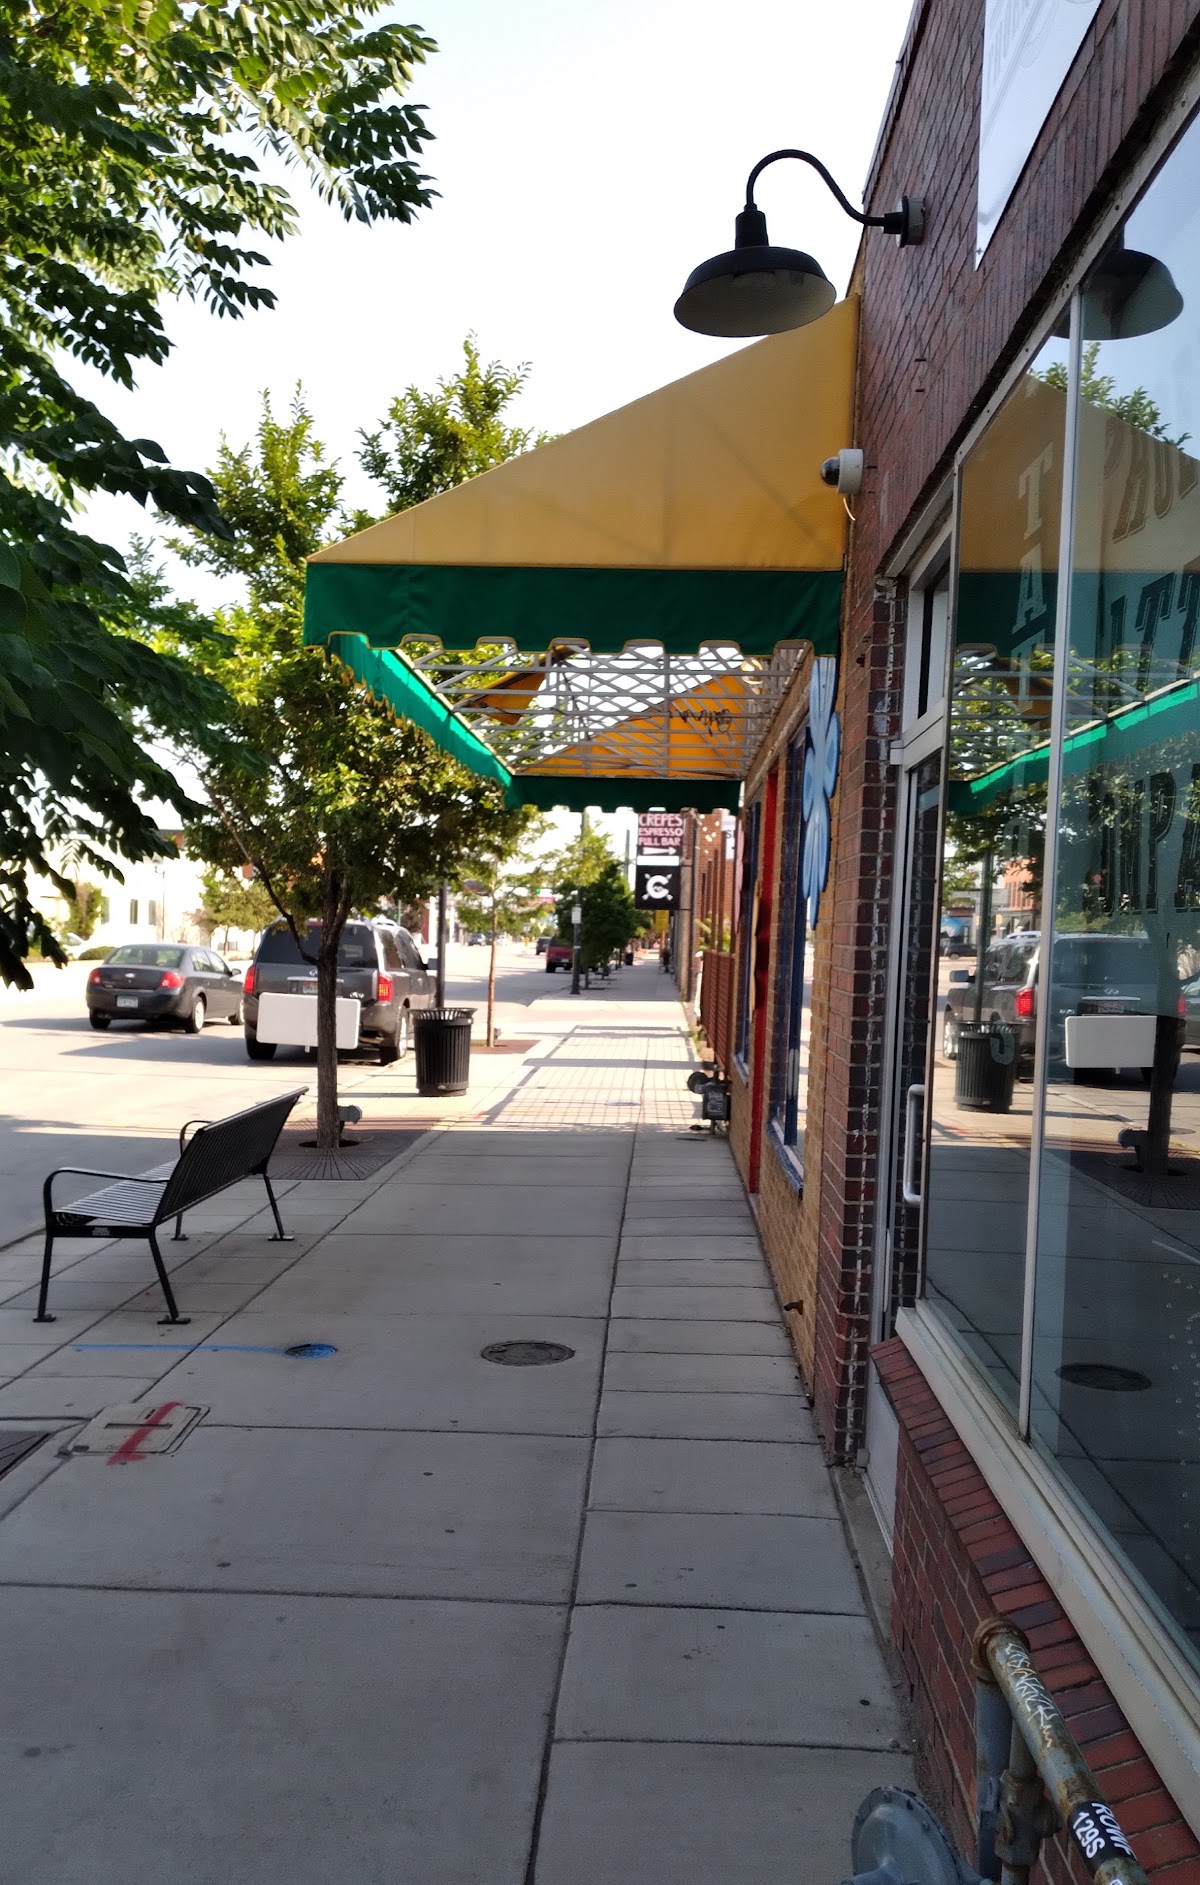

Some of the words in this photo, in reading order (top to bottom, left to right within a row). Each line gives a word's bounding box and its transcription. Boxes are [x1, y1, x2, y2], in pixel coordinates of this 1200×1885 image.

[638, 814, 683, 827] CREPES
[638, 828, 684, 837] ESPRESSO
[639, 837, 659, 846] FULL
[660, 837, 682, 846] BAR
